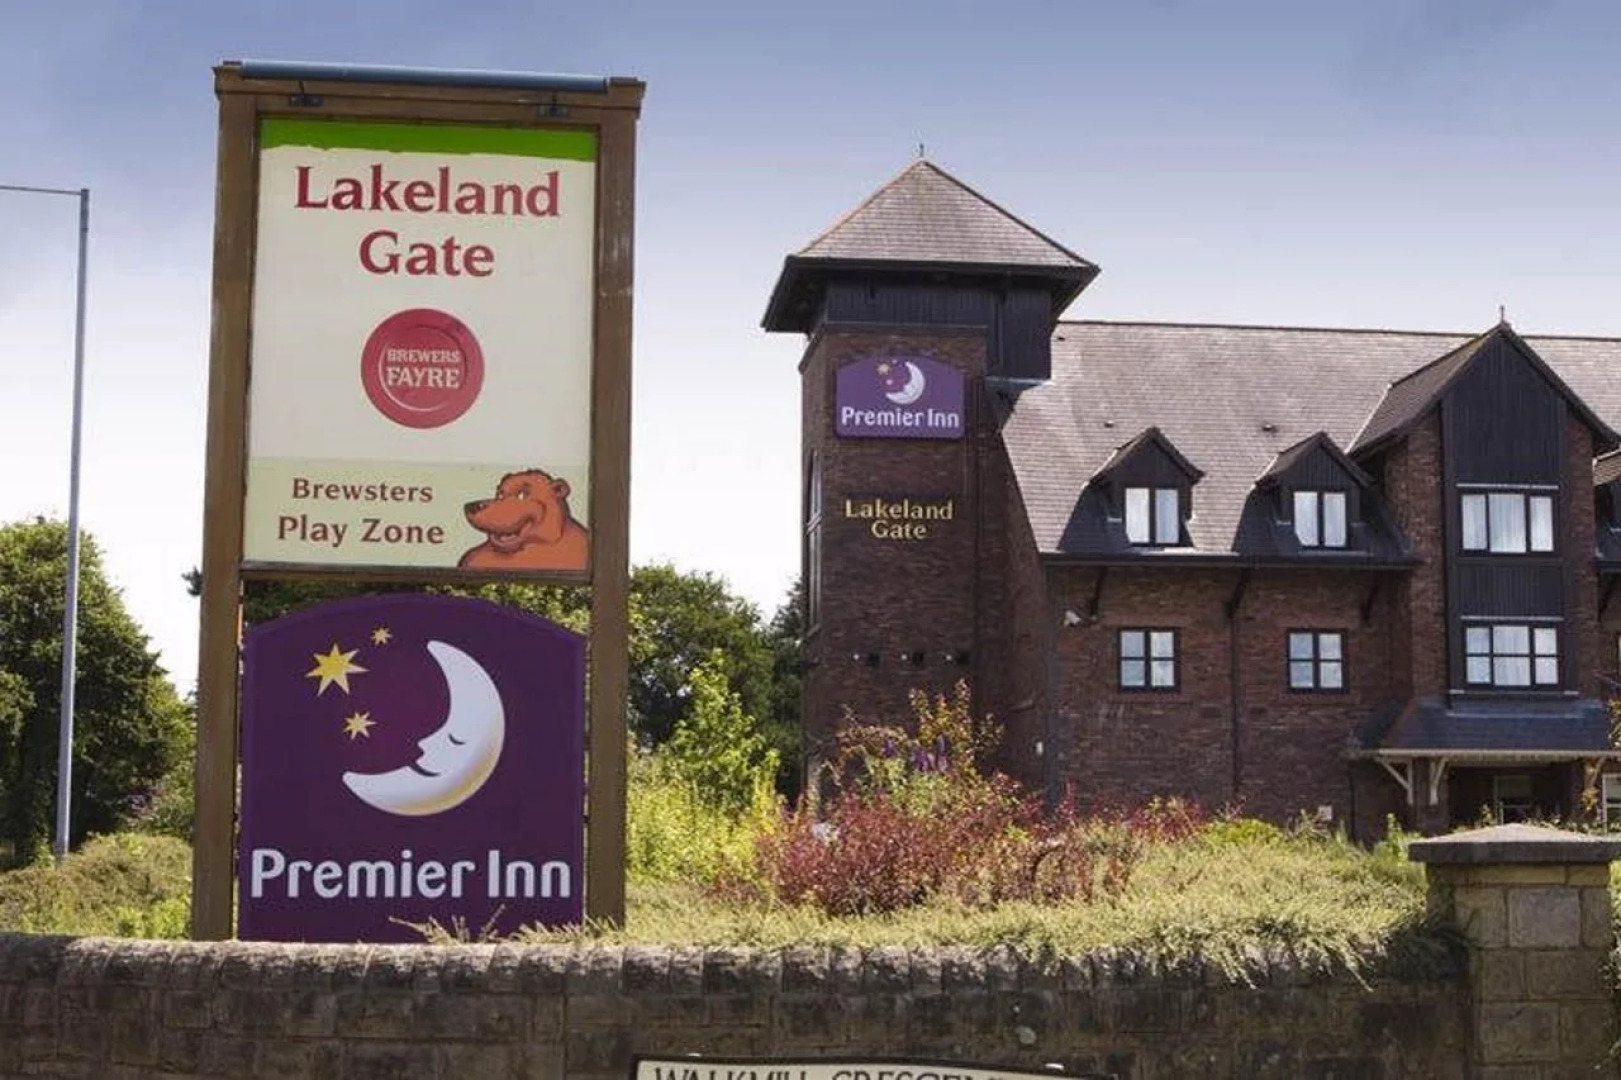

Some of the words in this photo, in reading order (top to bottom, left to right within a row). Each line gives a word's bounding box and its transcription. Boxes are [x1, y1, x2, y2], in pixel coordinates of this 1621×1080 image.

[294, 163, 560, 217] Lakeland
[359, 229, 496, 278] Gate
[386, 348, 461, 363] BREWERS
[386, 366, 461, 389] FAYRE
[841, 406, 925, 427] Premier
[927, 408, 960, 429] Inn
[292, 477, 434, 503] Brewsters
[845, 498, 954, 520] Lakeland
[277, 514, 347, 548] Play
[361, 518, 445, 545] Zone
[871, 520, 928, 539] Gate
[251, 848, 476, 899] Premier
[488, 849, 571, 899] Inn
